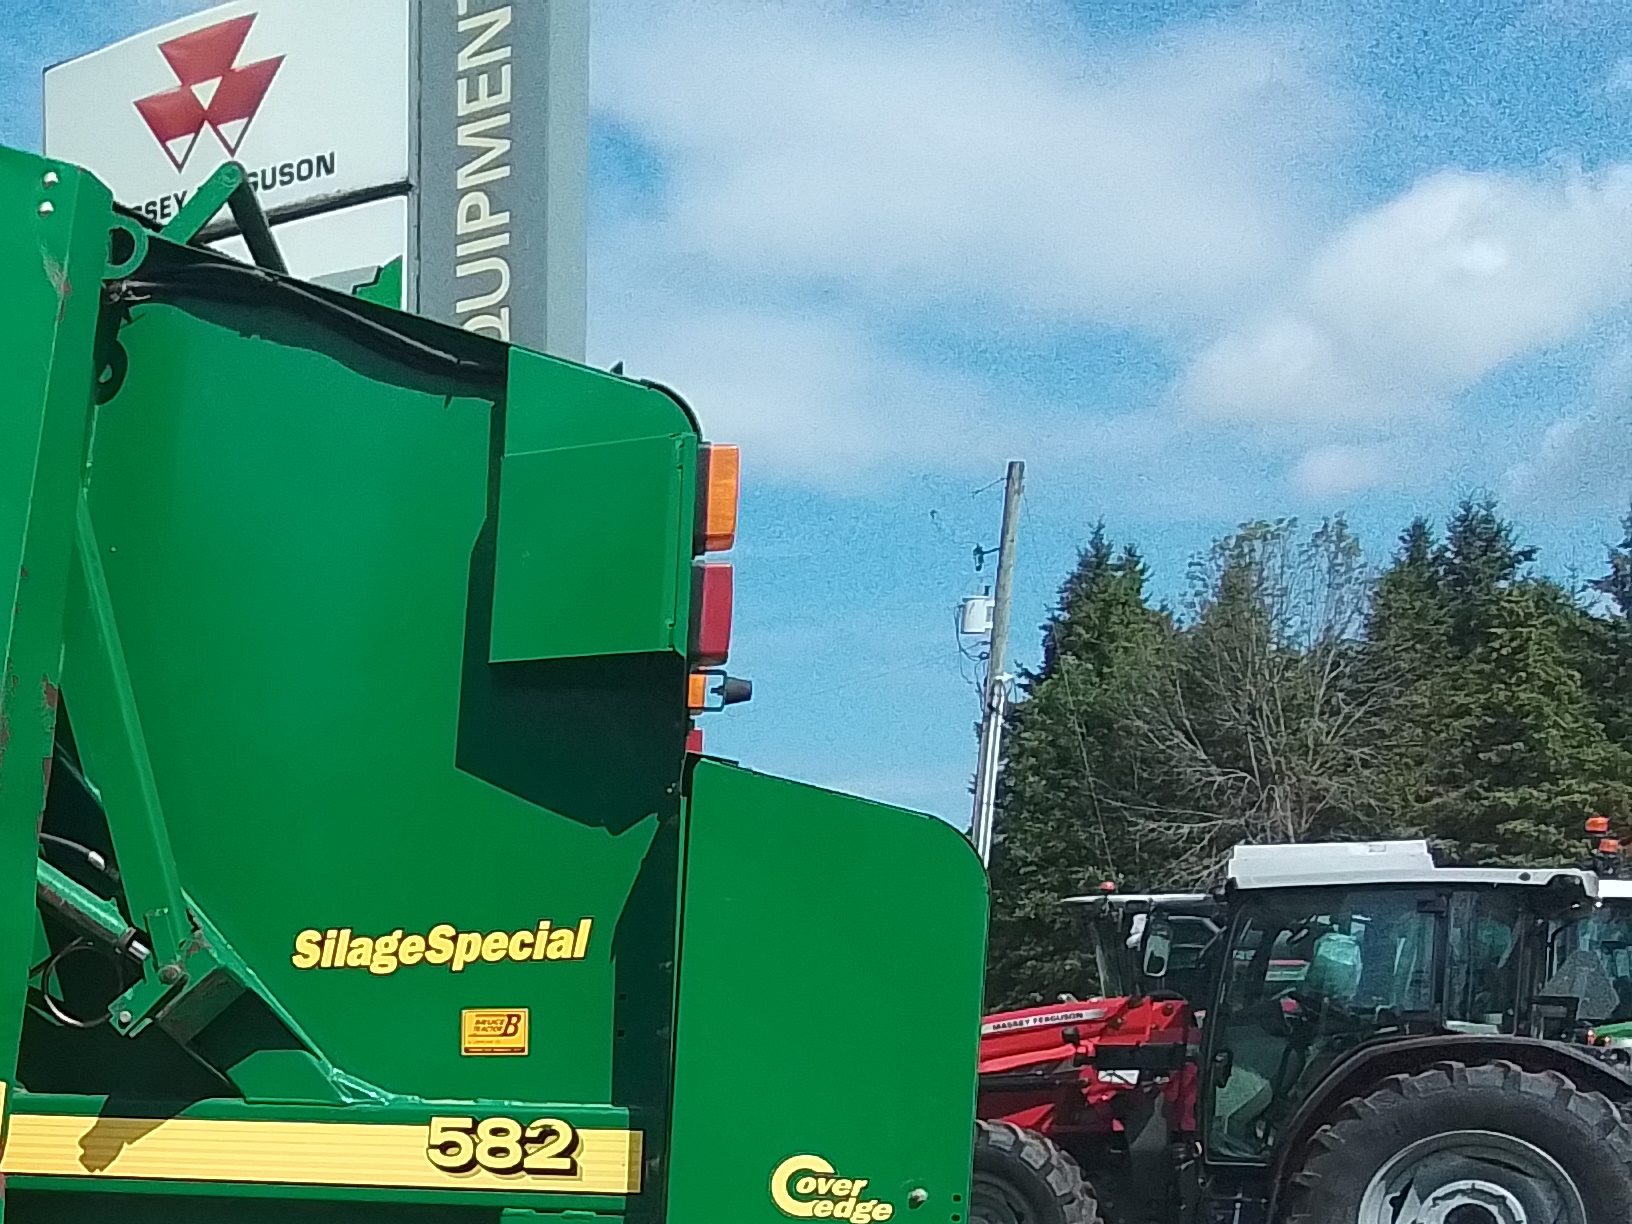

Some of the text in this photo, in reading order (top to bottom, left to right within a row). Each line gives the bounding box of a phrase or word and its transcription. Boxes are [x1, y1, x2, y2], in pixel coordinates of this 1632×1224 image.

[247, 152, 336, 193] GUSON
[292, 917, 593, 974] SilageSpecial
[993, 1012, 1084, 1031] MASSEY FERGUSON
[427, 1116, 581, 1179] 582
[771, 1154, 868, 1217] Cover
[813, 1198, 893, 1224] edge
